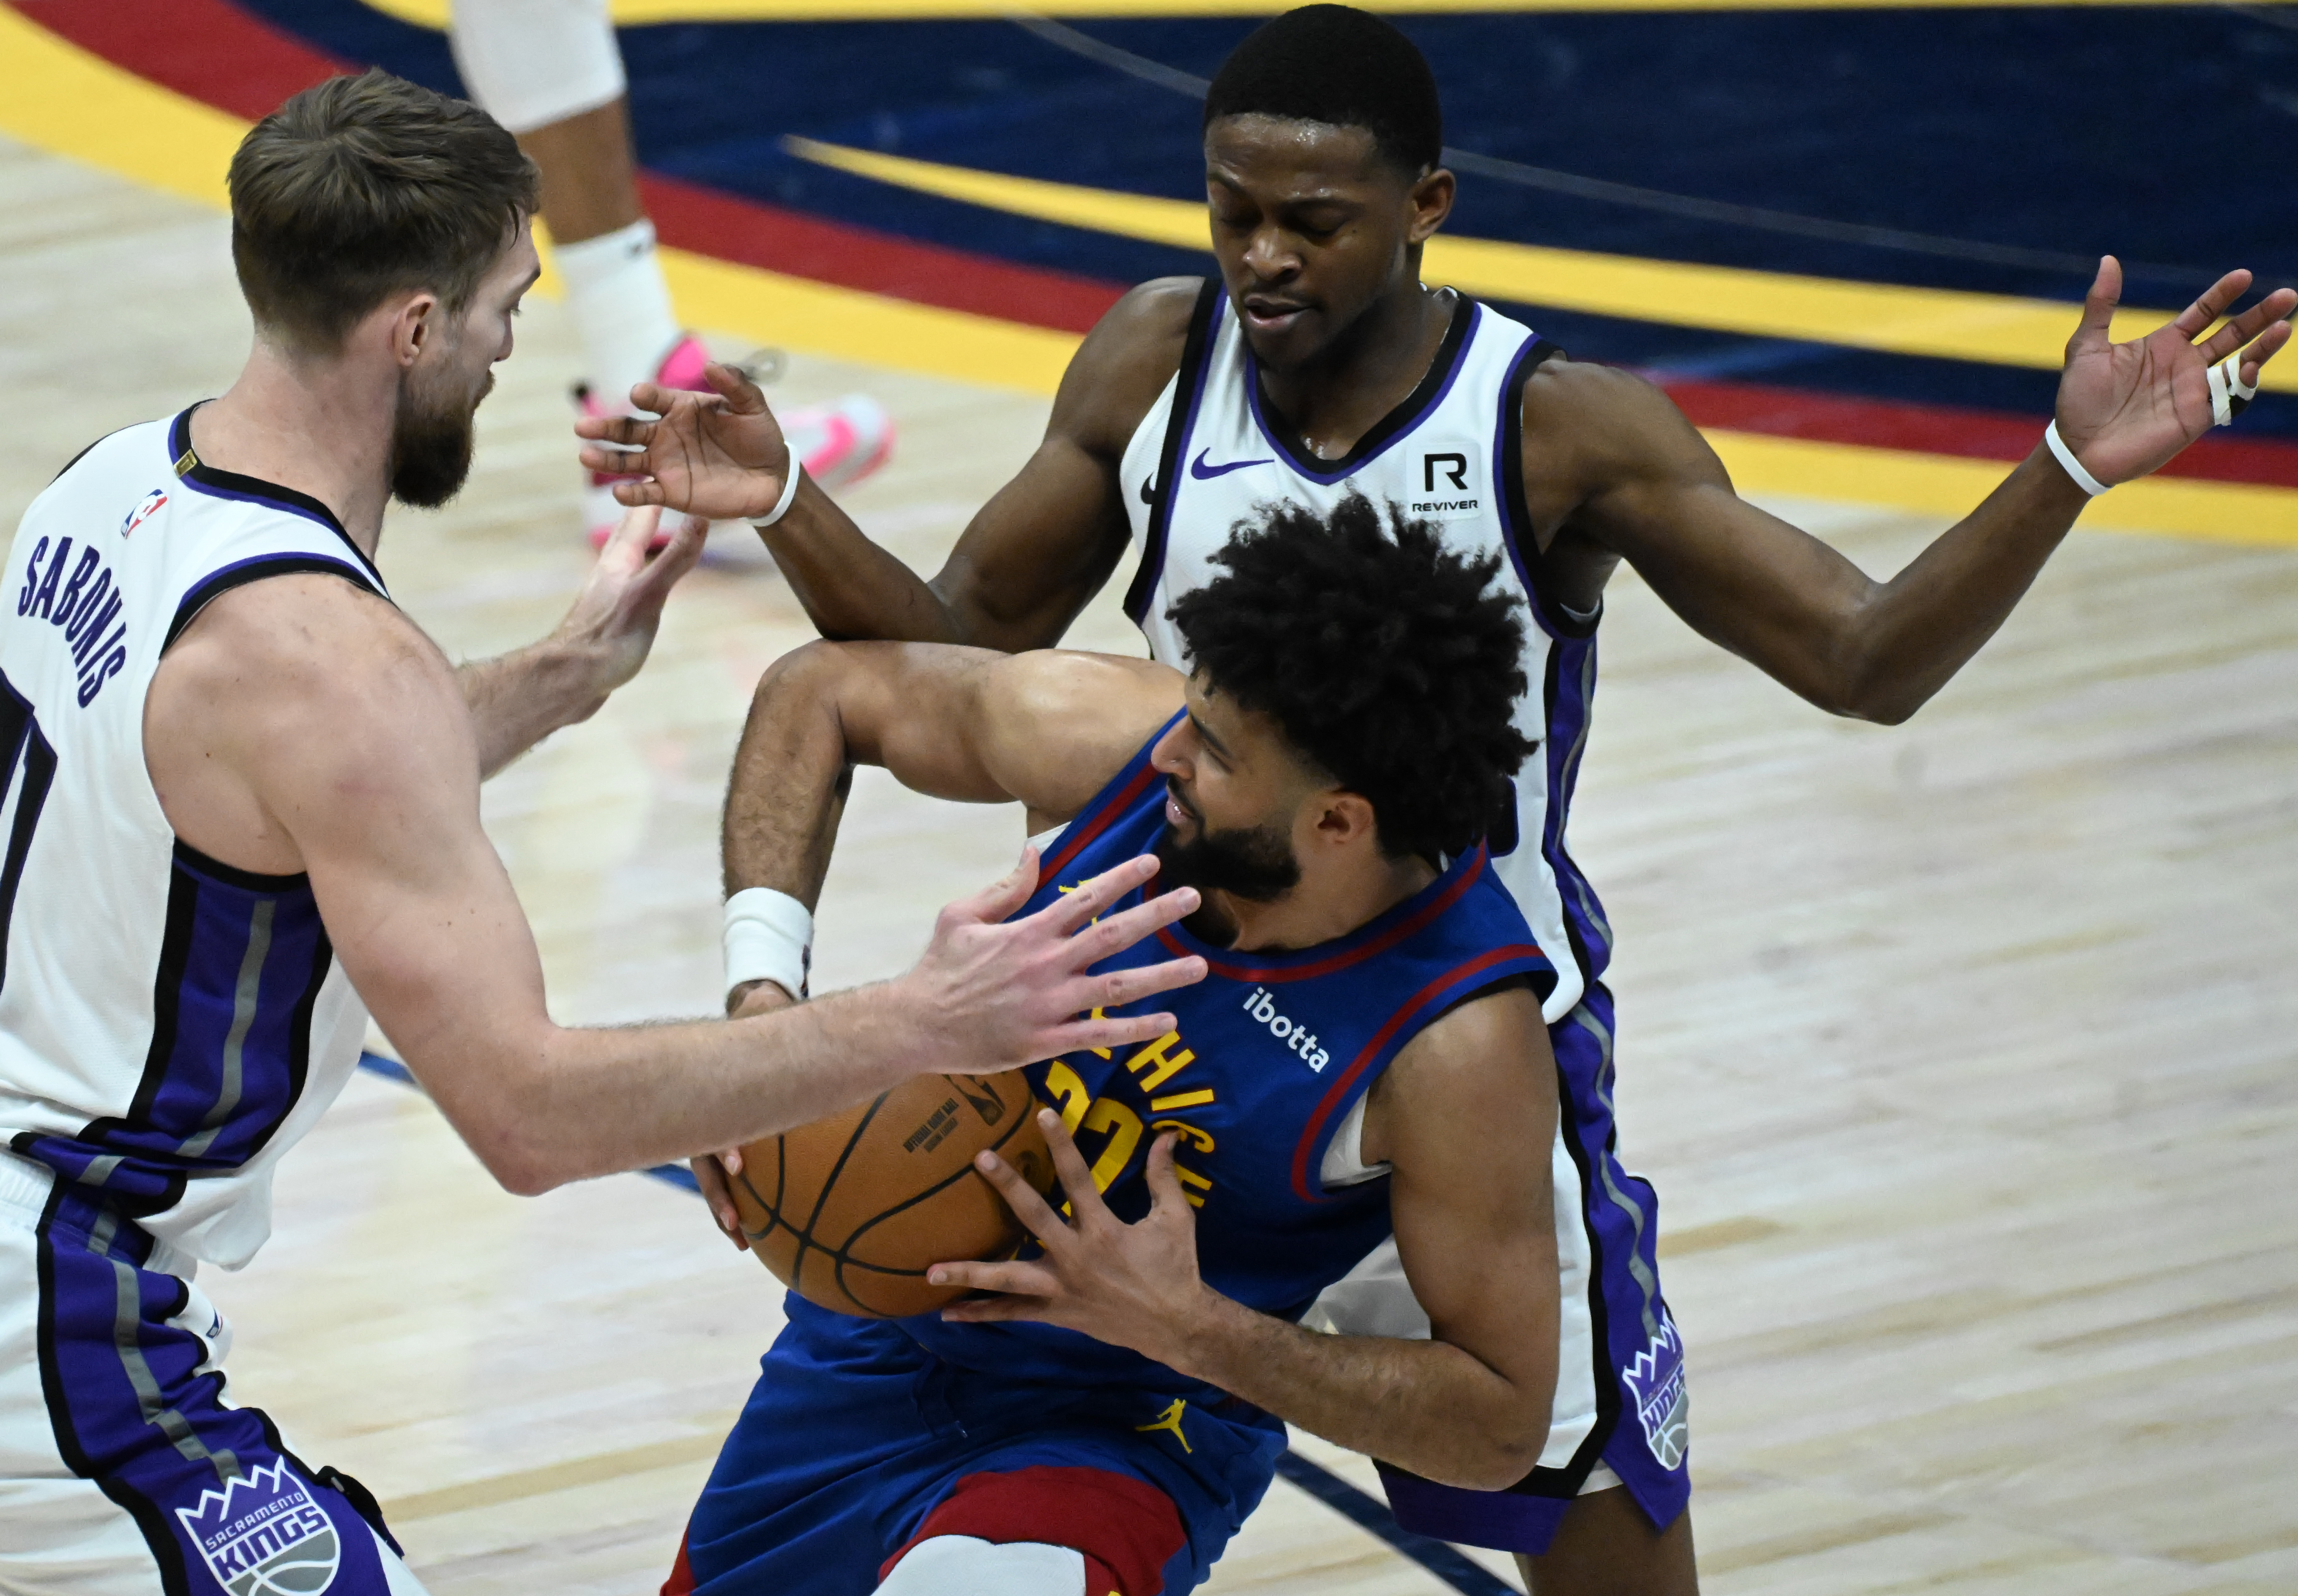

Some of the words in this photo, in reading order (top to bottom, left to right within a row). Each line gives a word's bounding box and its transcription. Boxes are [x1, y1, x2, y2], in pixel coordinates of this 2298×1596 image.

[1412, 500, 1478, 512] REVIVER
[1424, 453, 1468, 492] R
[18, 536, 126, 708] SABONIS
[1243, 987, 1330, 1073] ibotta
[205, 1492, 304, 1550] SACRAMENTO
[212, 1506, 328, 1582] KINGS
